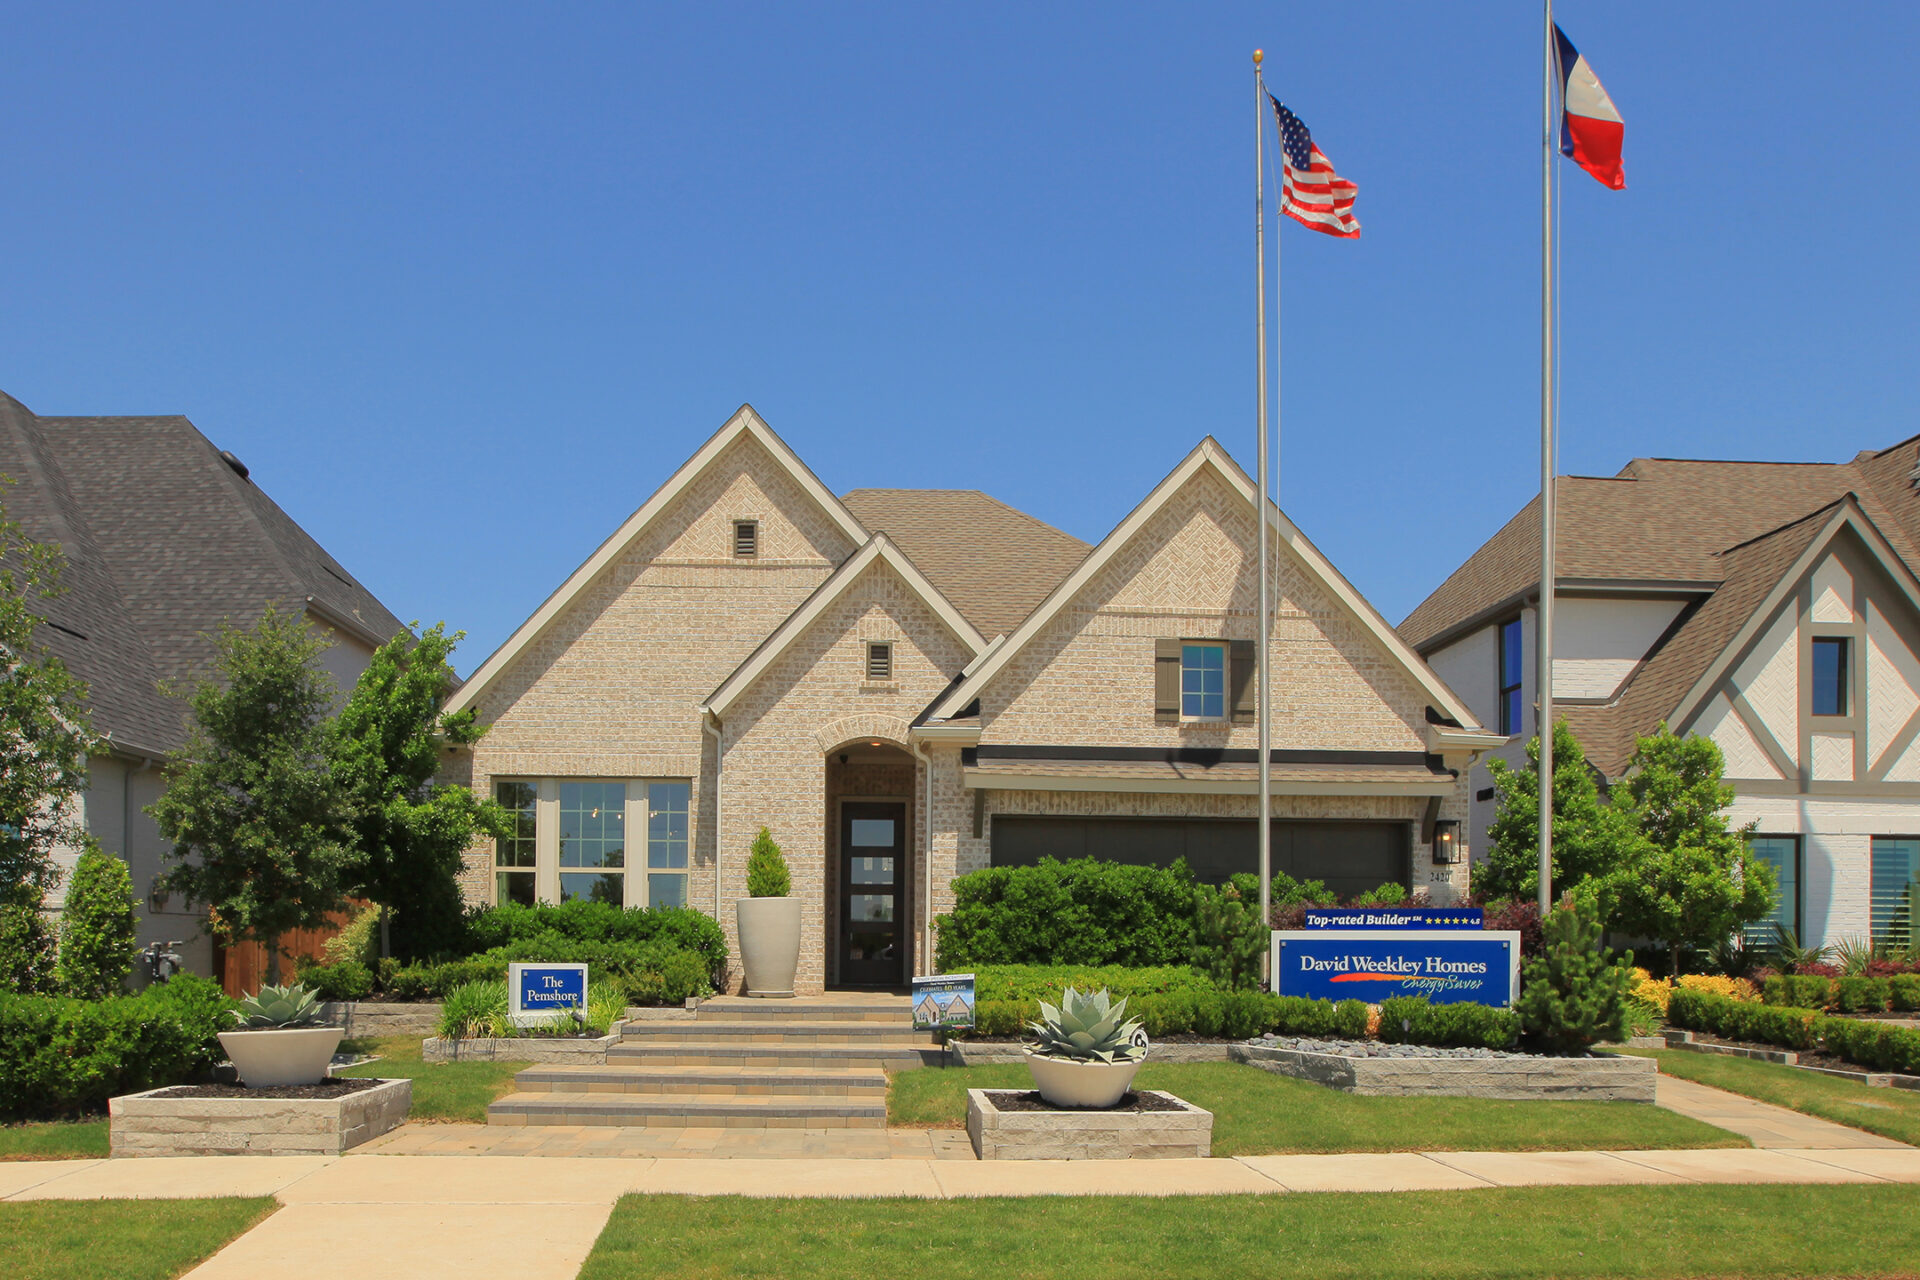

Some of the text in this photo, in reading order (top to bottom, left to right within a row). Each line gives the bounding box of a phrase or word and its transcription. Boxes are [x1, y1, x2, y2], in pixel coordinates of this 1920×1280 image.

[1307, 914, 1365, 928] Top-rated
[1365, 914, 1411, 925] Builder
[1300, 955, 1487, 976] David Weekley Homes
[542, 976, 564, 988] The
[527, 989, 578, 1002] Pemshore
